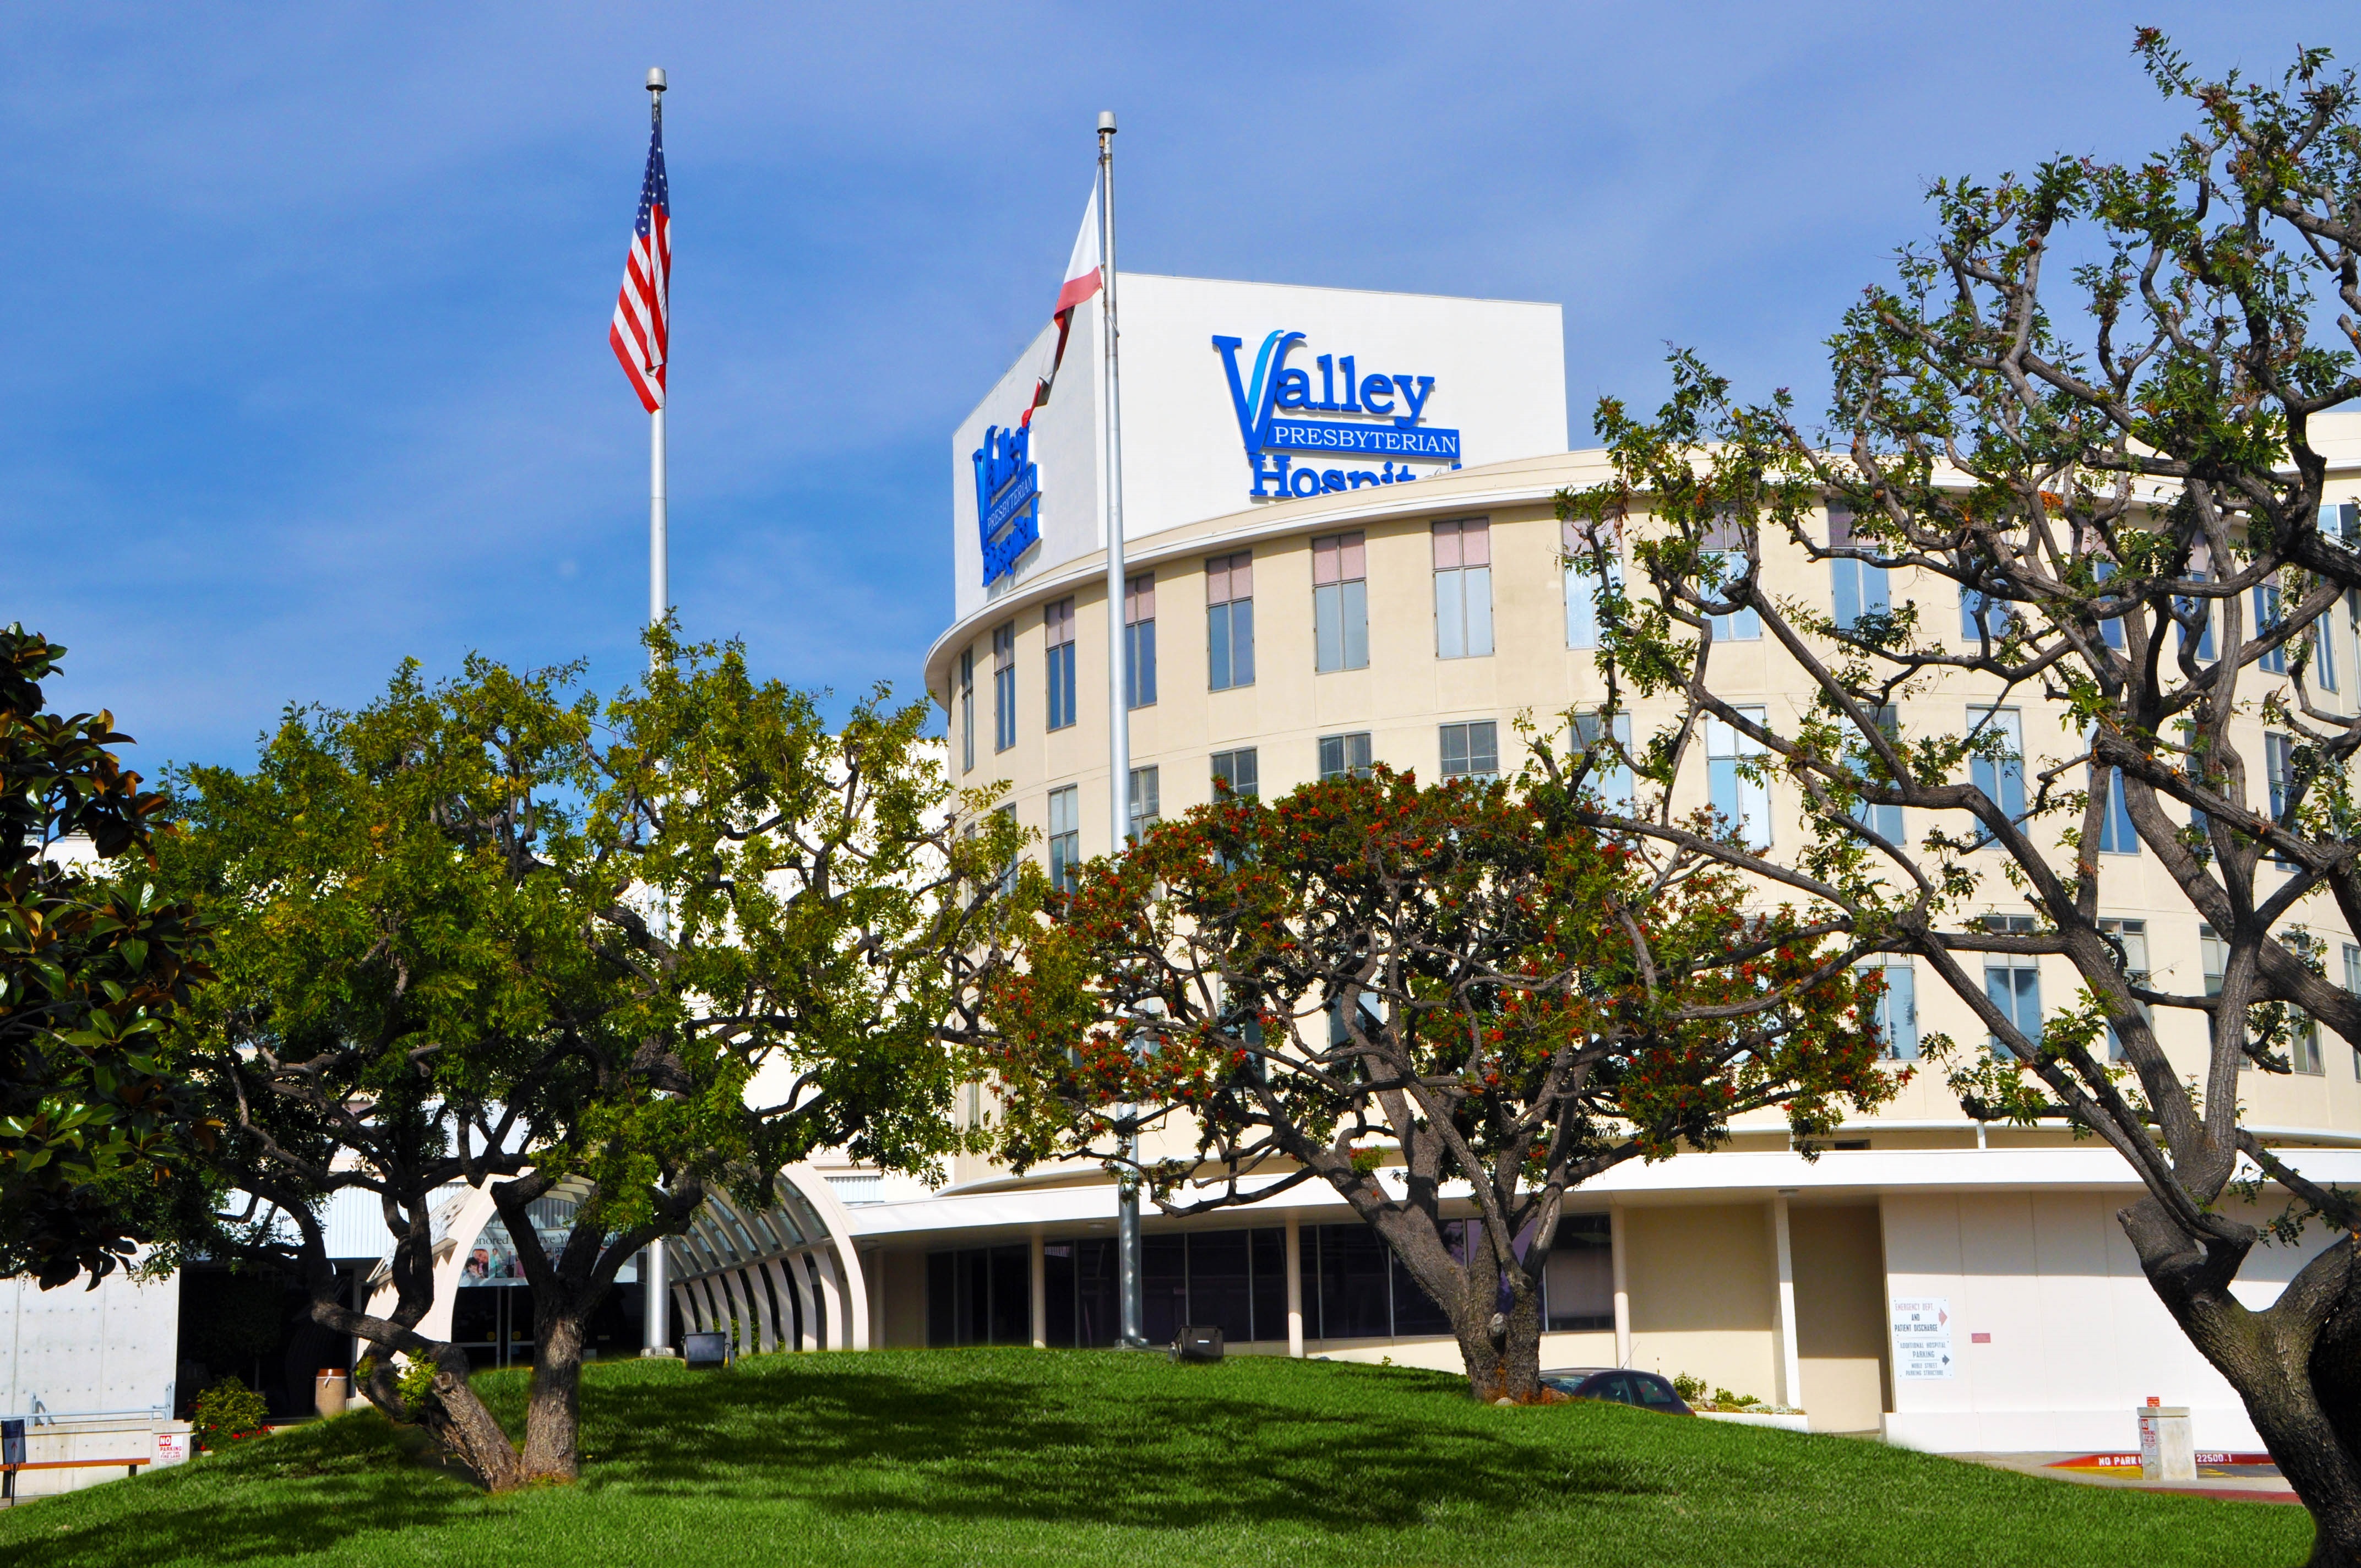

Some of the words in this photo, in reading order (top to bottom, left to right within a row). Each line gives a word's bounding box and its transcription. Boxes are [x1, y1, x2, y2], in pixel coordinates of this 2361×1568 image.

[1212, 330, 1435, 454] Valley
[1274, 425, 1457, 454] PRESBYTERIAN
[987, 473, 1032, 534] PRESBYTERIAN
[475, 1234, 509, 1244] onored
[160, 1436, 171, 1445] NO
[2098, 1457, 2110, 1466] NO
[2114, 1456, 2141, 1466] PARKI
[2196, 1453, 2233, 1463] 22500.1
